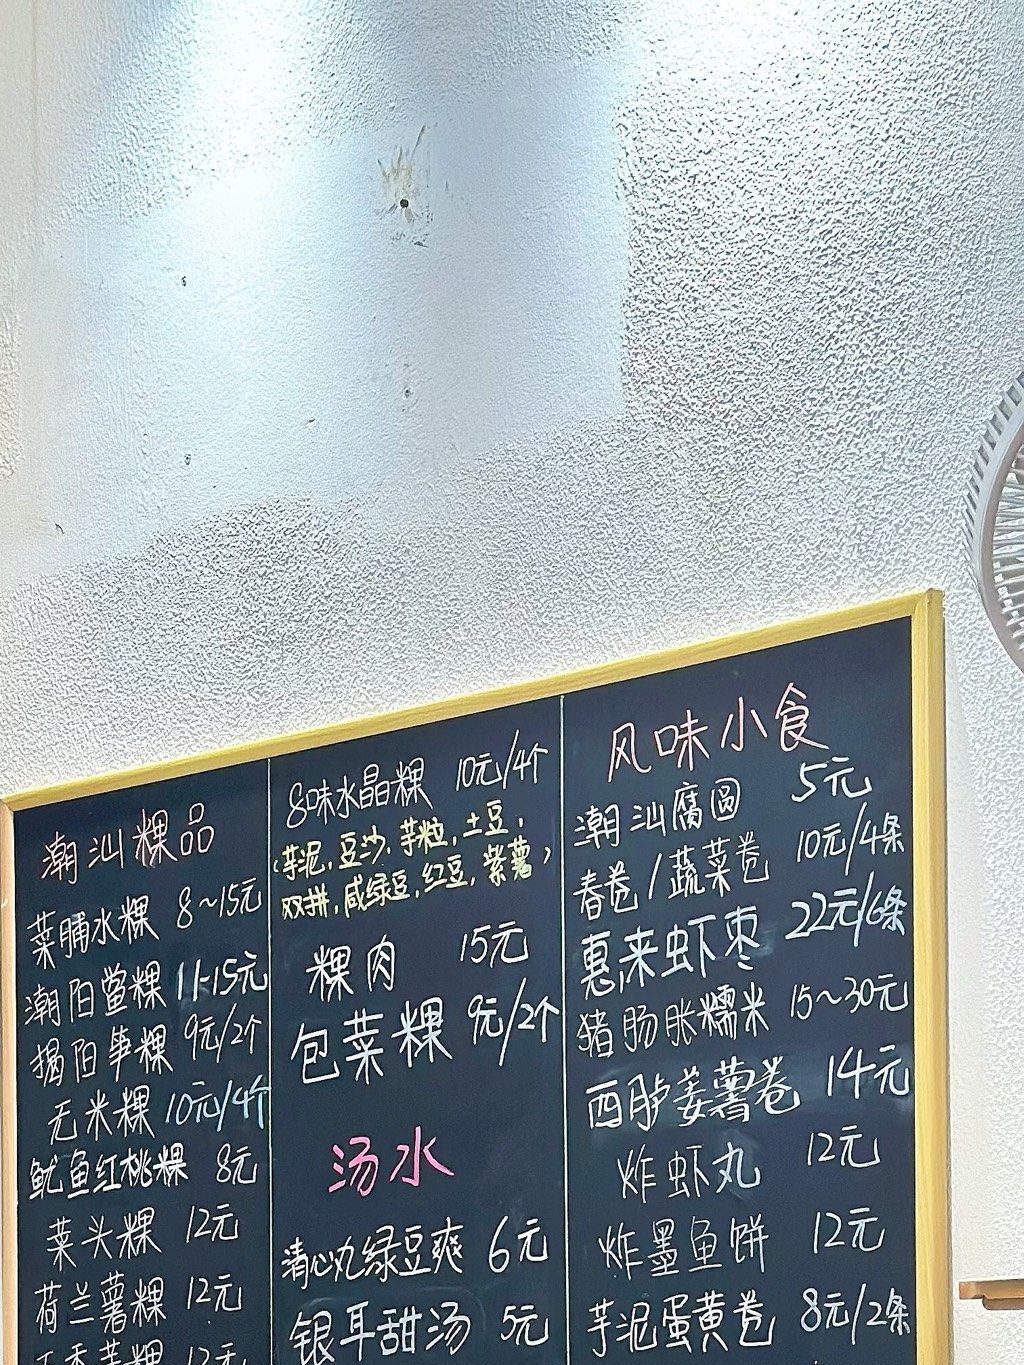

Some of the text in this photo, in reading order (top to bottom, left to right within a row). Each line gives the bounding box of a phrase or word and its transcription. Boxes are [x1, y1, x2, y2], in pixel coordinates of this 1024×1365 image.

[608, 682, 829, 783] 风味小食
[286, 729, 548, 829] 8味水晶粿 10元/4个
[574, 756, 873, 849] 潮汕腐圆 5元
[40, 802, 214, 885] 潮汕粿品
[573, 801, 905, 921] 春卷/蔬菜卷 10元/4条
[26, 877, 262, 970] 菜脯水粿 8~15元
[306, 921, 529, 1003] 粿肉 15元
[580, 871, 908, 1000] 惠来虾枣 22元/6条
[184, 1002, 262, 1063] 9元/2个
[290, 977, 560, 1085] 包菜粿 9元/2个
[576, 973, 909, 1059] 猪肠胀糯米 15~30元
[47, 1074, 270, 1145] 无米粿 10元/4个
[827, 1043, 910, 1100] 14元
[29, 1142, 258, 1200] 鱿鱼红桃粿 8元
[328, 1125, 455, 1198] 汤水
[616, 1124, 881, 1204] 炸虾丸 12元
[46, 1203, 239, 1272] 菜头粿 12元
[281, 1215, 549, 1289] 清心丸绿豆爽 6元
[599, 1206, 885, 1282] 炸墨鱼饼 12元
[34, 1270, 243, 1336] 荷兰薯粿 12元
[500, 1304, 549, 1347] 5元
[588, 1283, 911, 1357] 芋泥蛋黄卷 8元/2条
